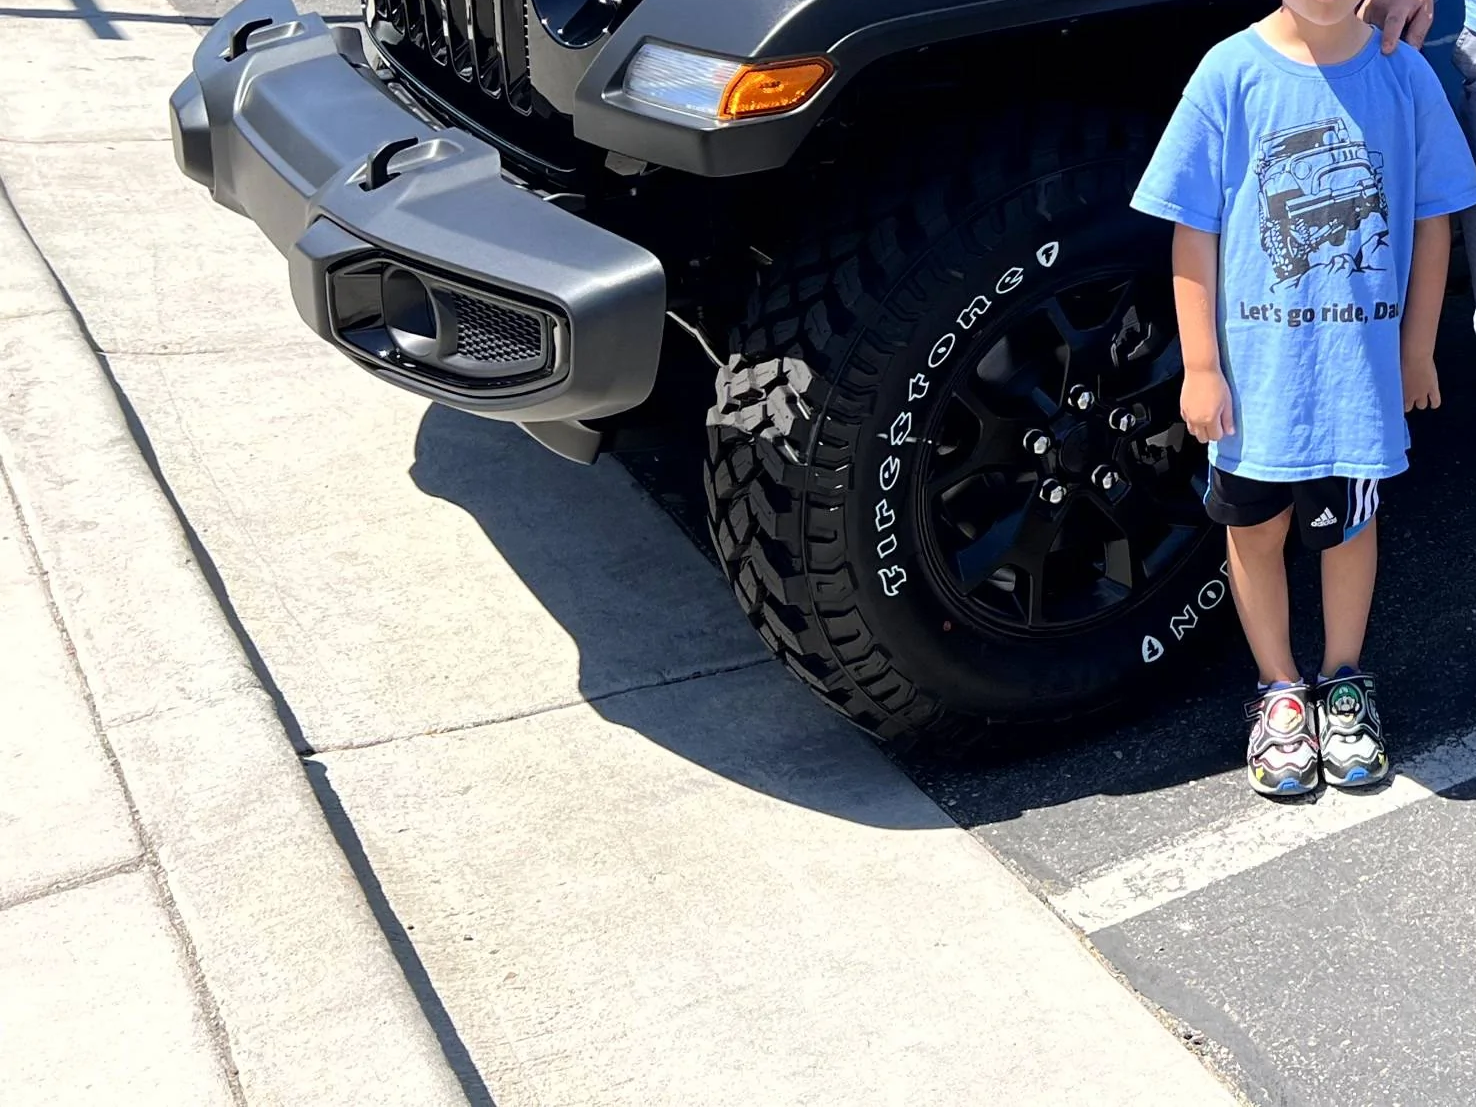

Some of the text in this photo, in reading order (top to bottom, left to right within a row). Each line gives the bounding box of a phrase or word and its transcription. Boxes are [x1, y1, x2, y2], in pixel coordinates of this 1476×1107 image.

[1240, 301, 1399, 327] Let's go ride, Da
[876, 267, 1024, 596] Firestone
